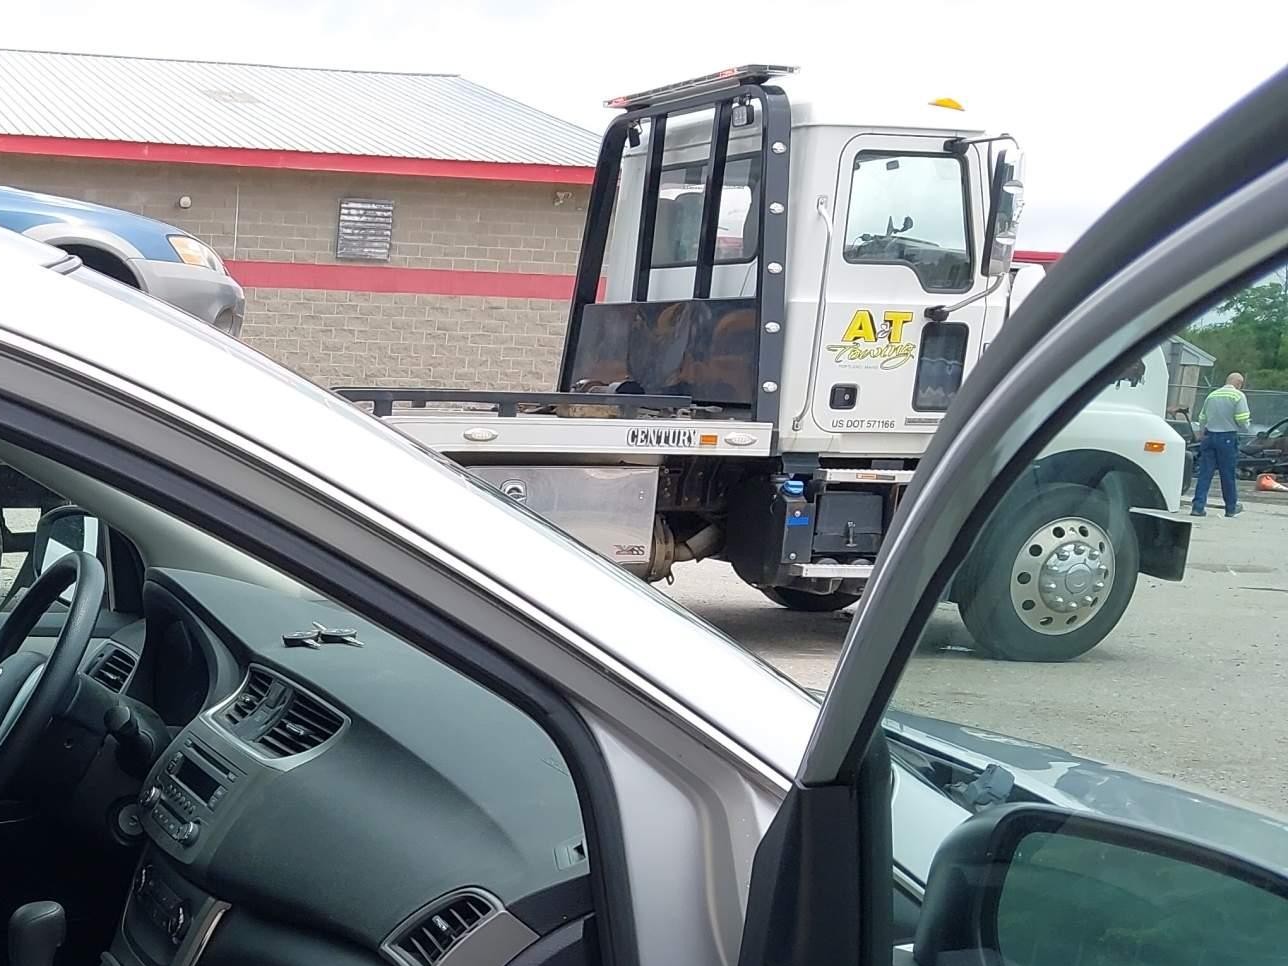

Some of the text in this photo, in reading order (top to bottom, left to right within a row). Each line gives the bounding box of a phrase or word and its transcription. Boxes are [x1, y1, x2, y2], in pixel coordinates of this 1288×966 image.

[825, 341, 917, 371] Towing
[831, 419, 895, 429] US DOT 571166
[626, 427, 697, 448] CENTURY
